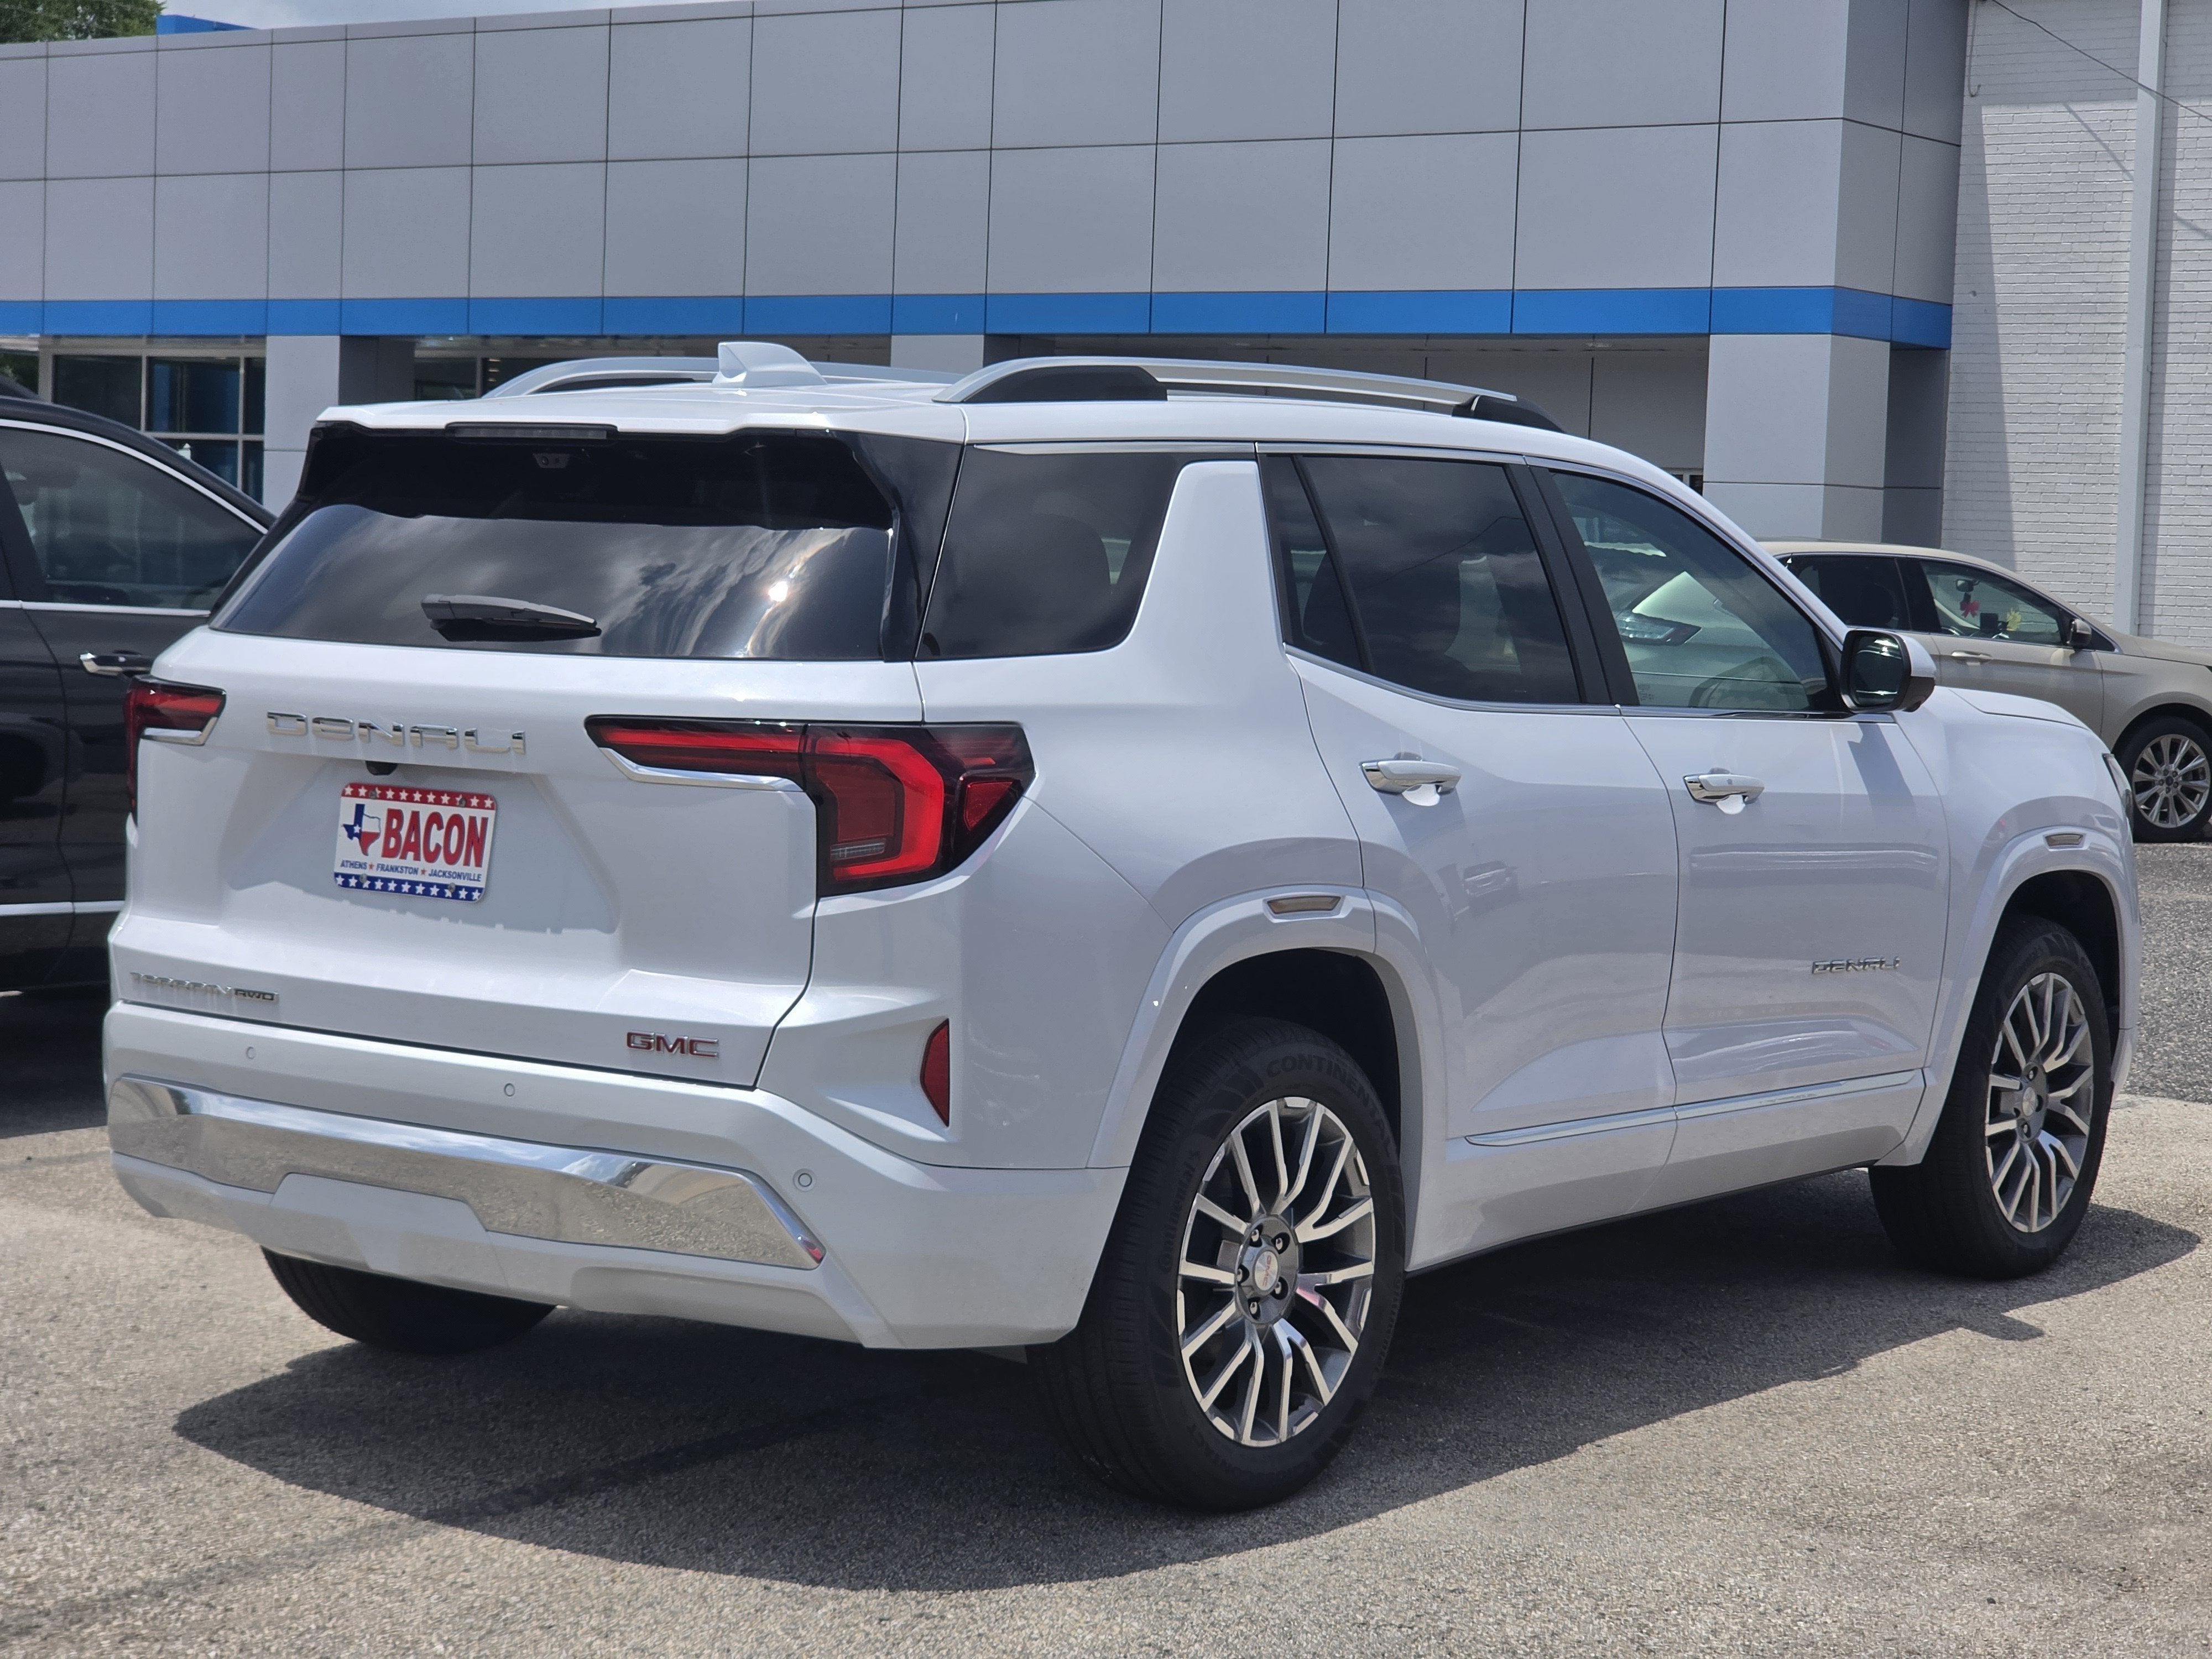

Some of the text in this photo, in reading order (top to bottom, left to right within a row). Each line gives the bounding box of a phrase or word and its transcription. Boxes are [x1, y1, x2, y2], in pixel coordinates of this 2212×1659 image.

[267, 711, 526, 754] DENALI
[381, 808, 489, 868] BACON
[340, 859, 482, 882] ATHENS FRANKSTON JACKSONVILLE
[1811, 956, 1901, 974] DENALI
[626, 1029, 718, 1058] GMC
